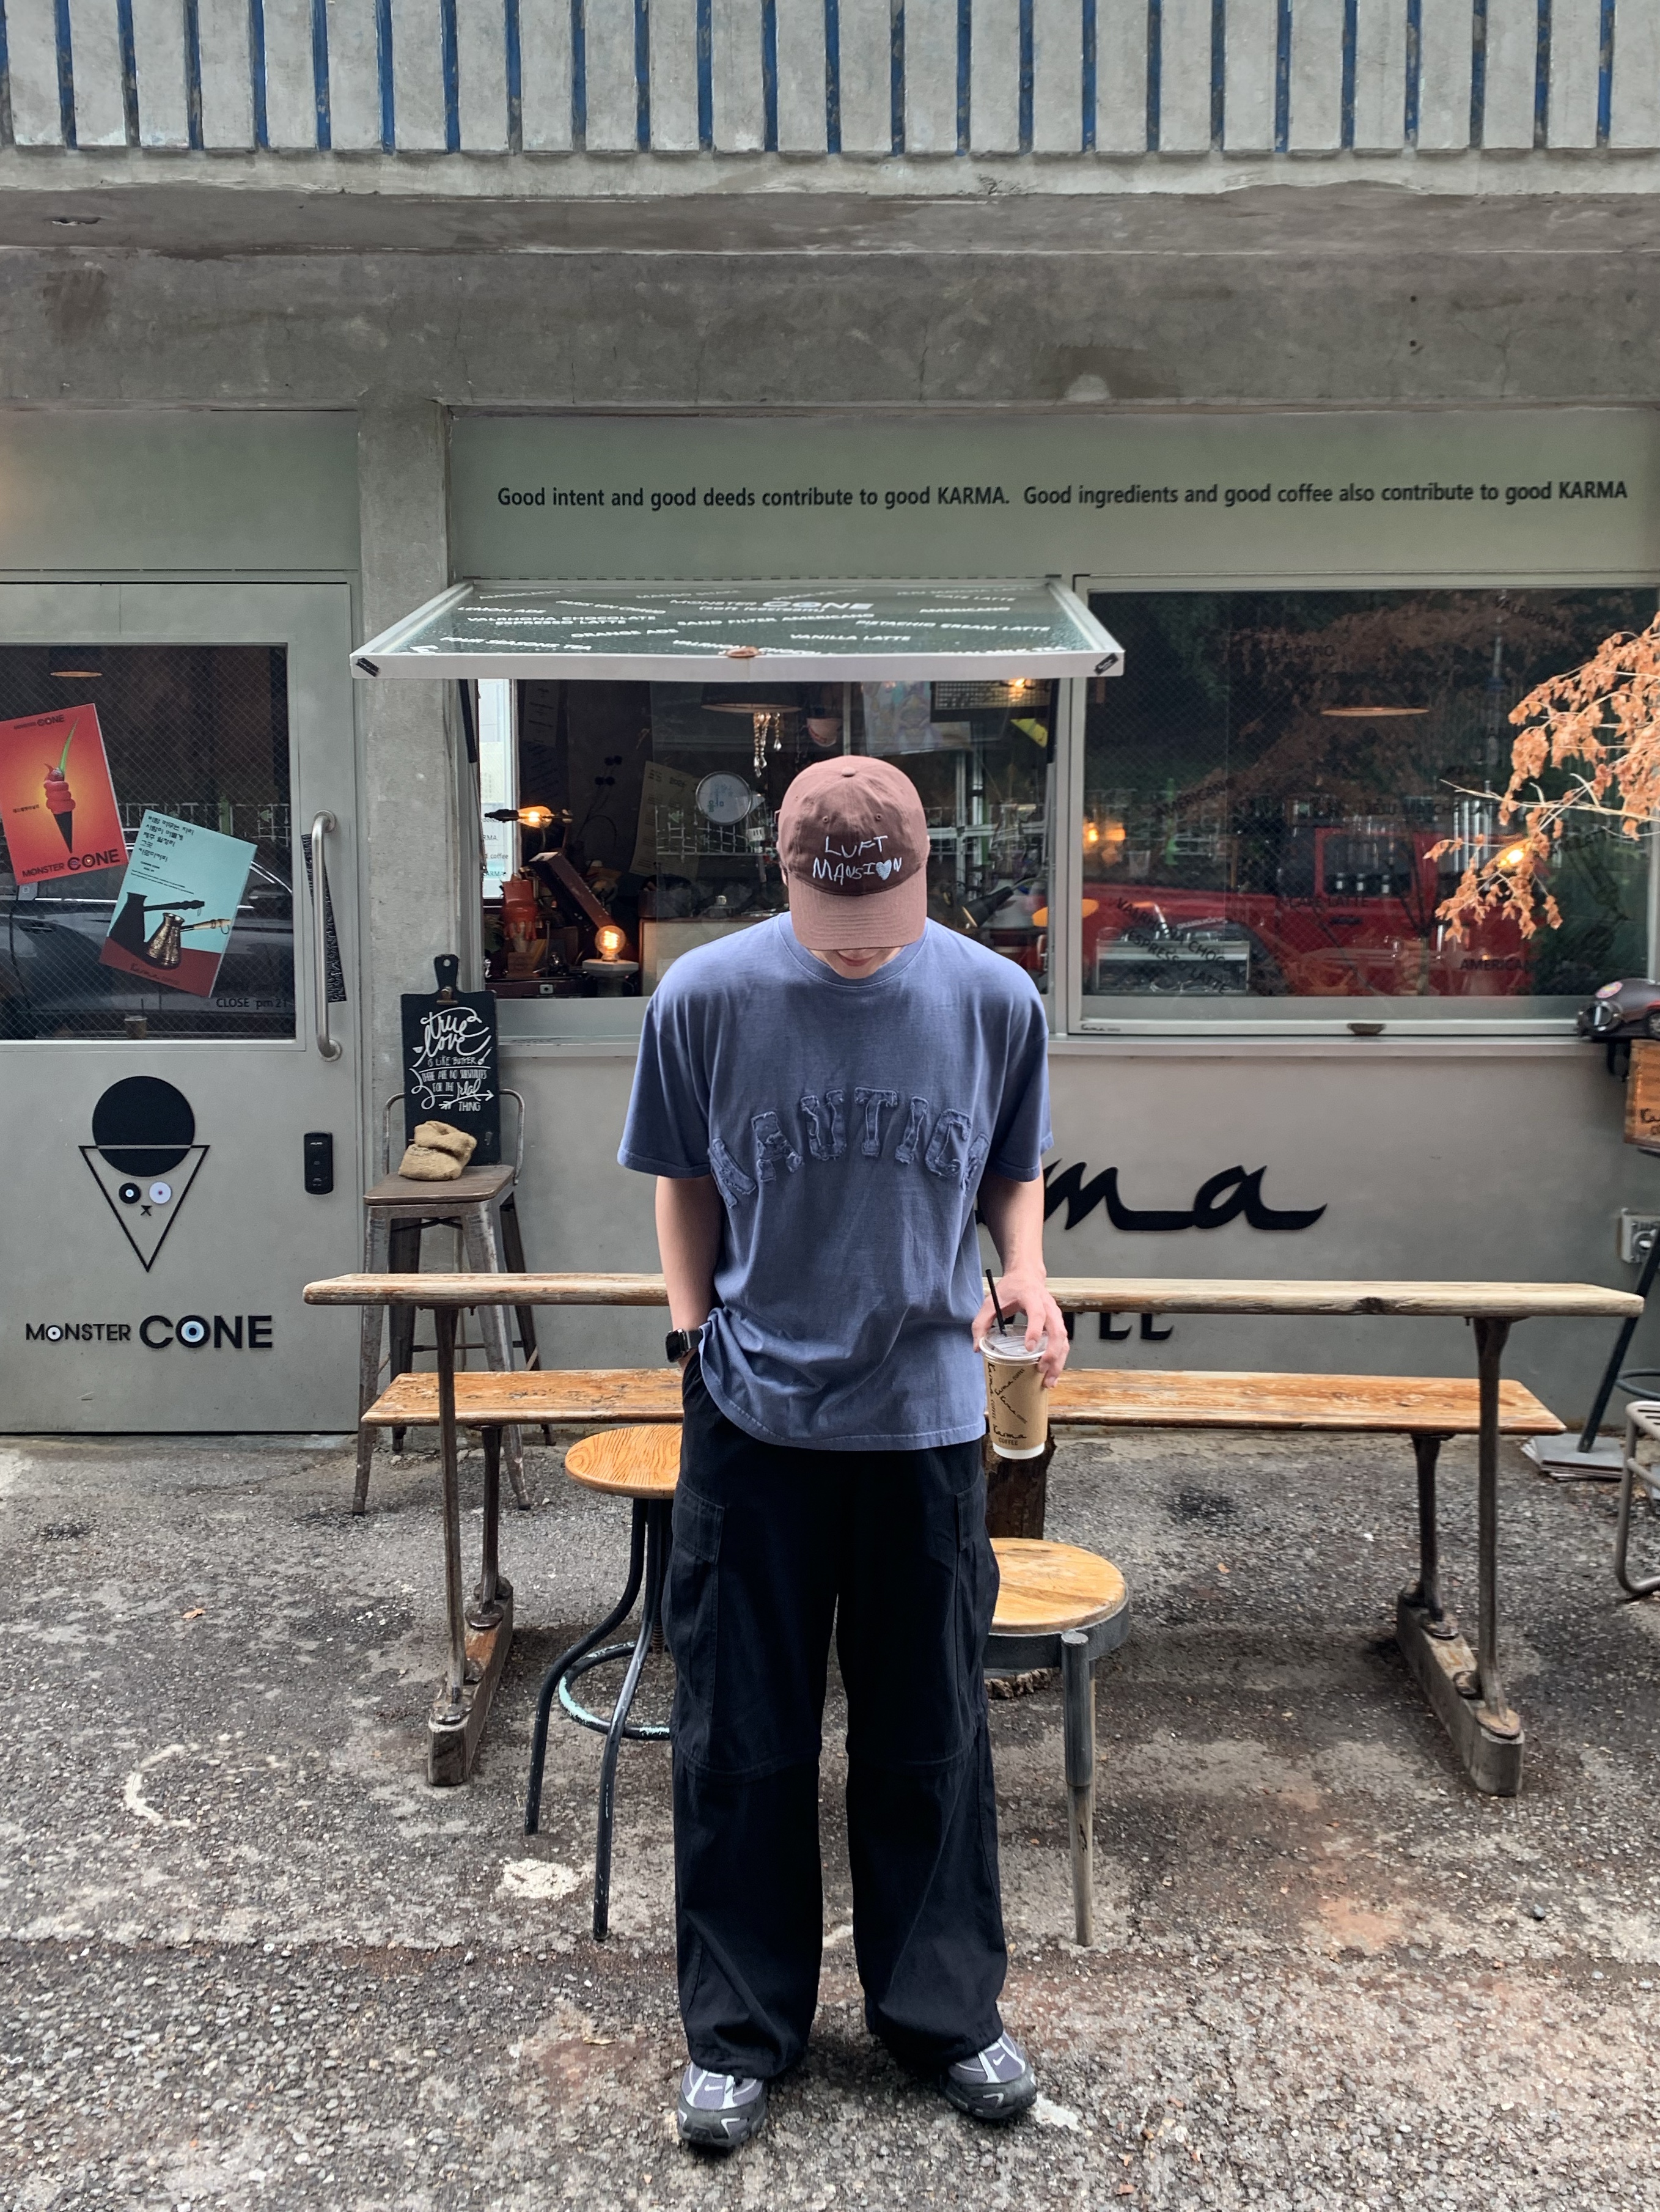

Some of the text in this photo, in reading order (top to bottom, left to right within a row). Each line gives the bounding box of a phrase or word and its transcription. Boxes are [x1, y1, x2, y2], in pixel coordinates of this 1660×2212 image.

[498, 480, 1629, 513] Good intent and good deeds contribute to good KARMA. Good ingredients and good coffee also contribute to good KARMA
[762, 600, 875, 610] CONE
[37, 714, 65, 726] CONE
[824, 835, 889, 859] LUFT
[21, 848, 121, 878] MONSTER CONE
[216, 997, 250, 1008] CLOSE
[255, 1000, 274, 1010] pm
[427, 1057, 433, 1067] IS
[435, 1056, 451, 1066] LIKE
[432, 1082, 444, 1092] FOR
[445, 1082, 454, 1092] THE
[458, 1101, 482, 1112] THING
[25, 1315, 273, 1350] MONSTER CONE
[993, 1424, 1027, 1446] Karma COFFEE
